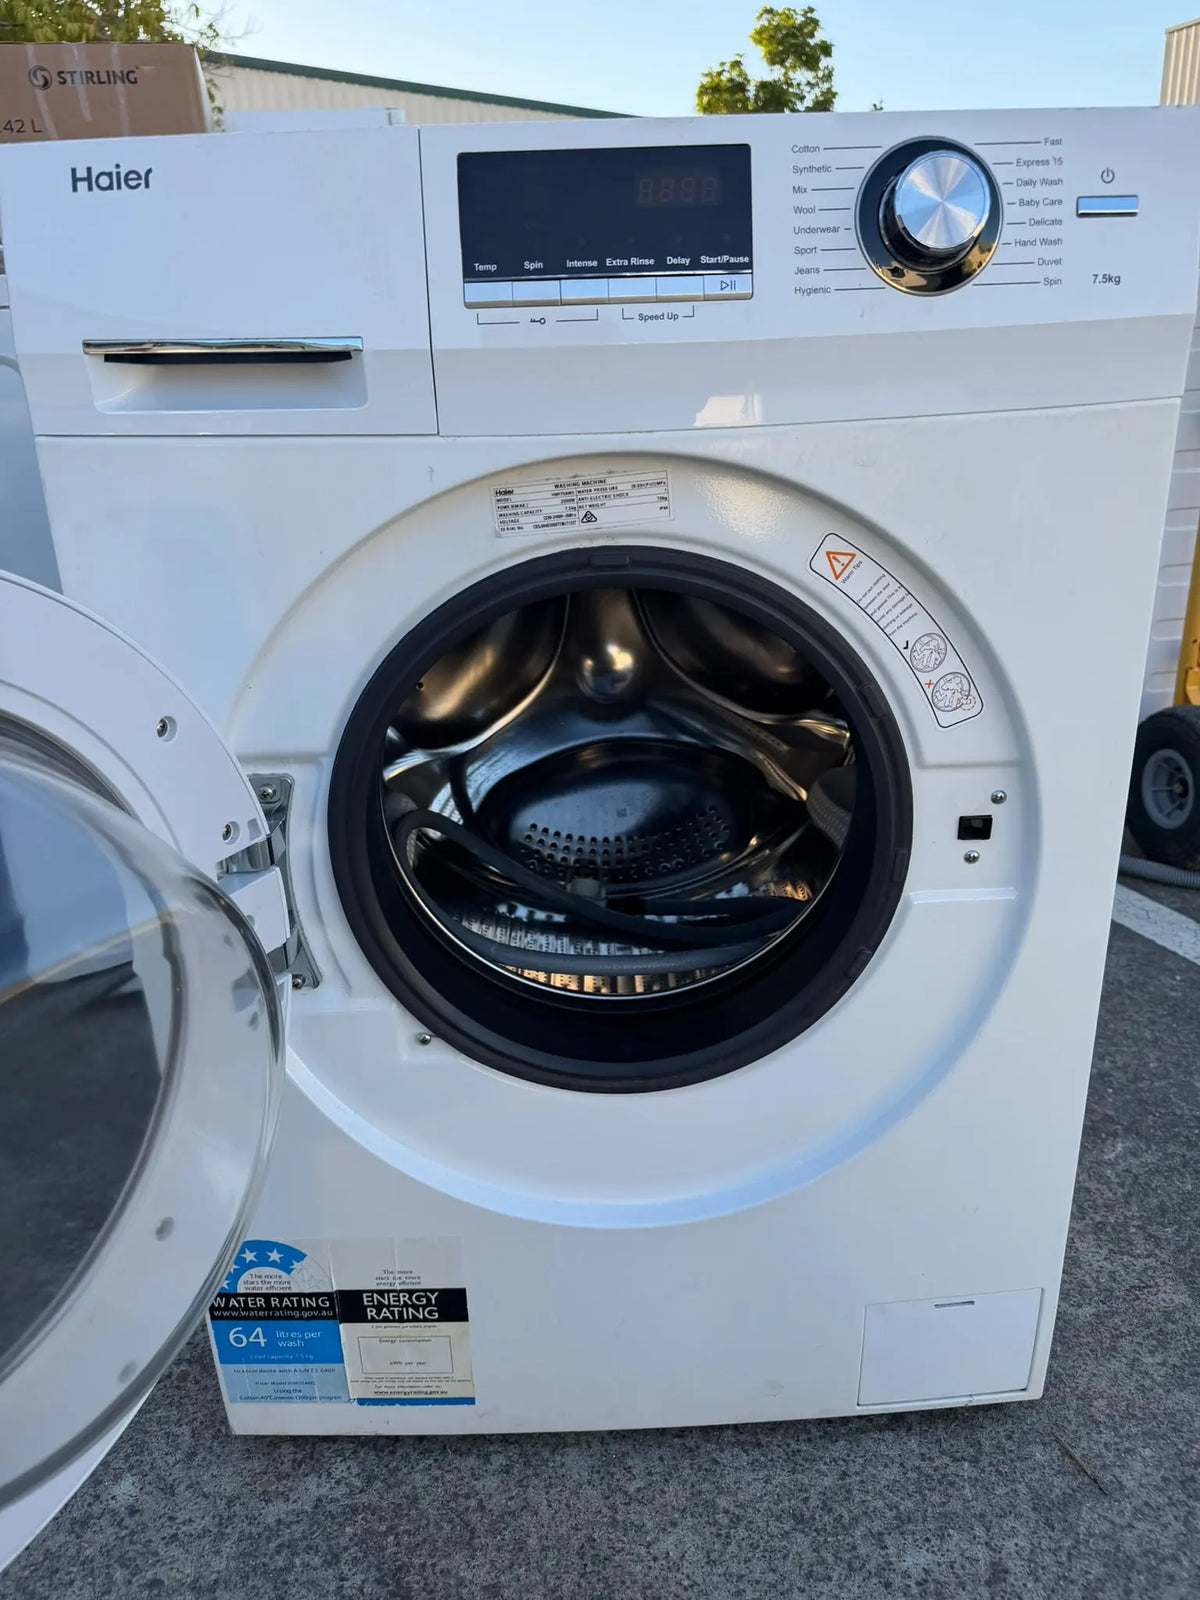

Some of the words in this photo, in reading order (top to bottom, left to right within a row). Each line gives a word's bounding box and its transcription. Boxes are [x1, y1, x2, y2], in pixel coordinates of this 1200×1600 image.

[58, 70, 138, 85] STIRLING
[32, 119, 43, 133] L
[1044, 138, 1062, 146] Fast
[792, 144, 820, 154] Cotton
[1016, 158, 1050, 168] Express
[792, 164, 832, 175] Synthetic
[70, 163, 152, 193] Haier
[1016, 178, 1038, 188] Daily
[1040, 178, 1063, 186] Wash
[792, 185, 808, 194] Mix
[1018, 198, 1040, 208] Baby
[1042, 198, 1063, 206] Care
[793, 205, 816, 214] Wool
[1029, 218, 1062, 226] Delicate
[793, 226, 840, 234] Underwear
[1014, 238, 1037, 247] Hand
[1040, 237, 1062, 246] Wash
[794, 246, 817, 256] Sport
[566, 259, 598, 268] Intense
[606, 258, 628, 266] Extra
[630, 256, 655, 265] Rinse
[666, 256, 691, 266] Delay
[700, 255, 750, 264] Start/Pause
[1037, 258, 1062, 266] Duvet
[474, 262, 498, 272] Temp
[524, 260, 544, 270] Spin
[794, 266, 820, 275] Jeans
[1043, 278, 1062, 287] Spin
[1092, 273, 1121, 286] 7.5kg
[794, 285, 831, 296] Hygienic
[638, 312, 665, 322] Speed
[668, 312, 679, 321] Up
[841, 569, 854, 583] Warm
[852, 560, 862, 570] Tips
[212, 1296, 266, 1308] WATER
[271, 1296, 330, 1308] RATING
[362, 1292, 439, 1306] ENERGY
[213, 1309, 333, 1318] www.waterrating.gov.au
[367, 1307, 439, 1320] RATING
[229, 1327, 267, 1348] 64
[276, 1330, 302, 1338] litres
[304, 1330, 322, 1340] per
[278, 1339, 304, 1347] wash
